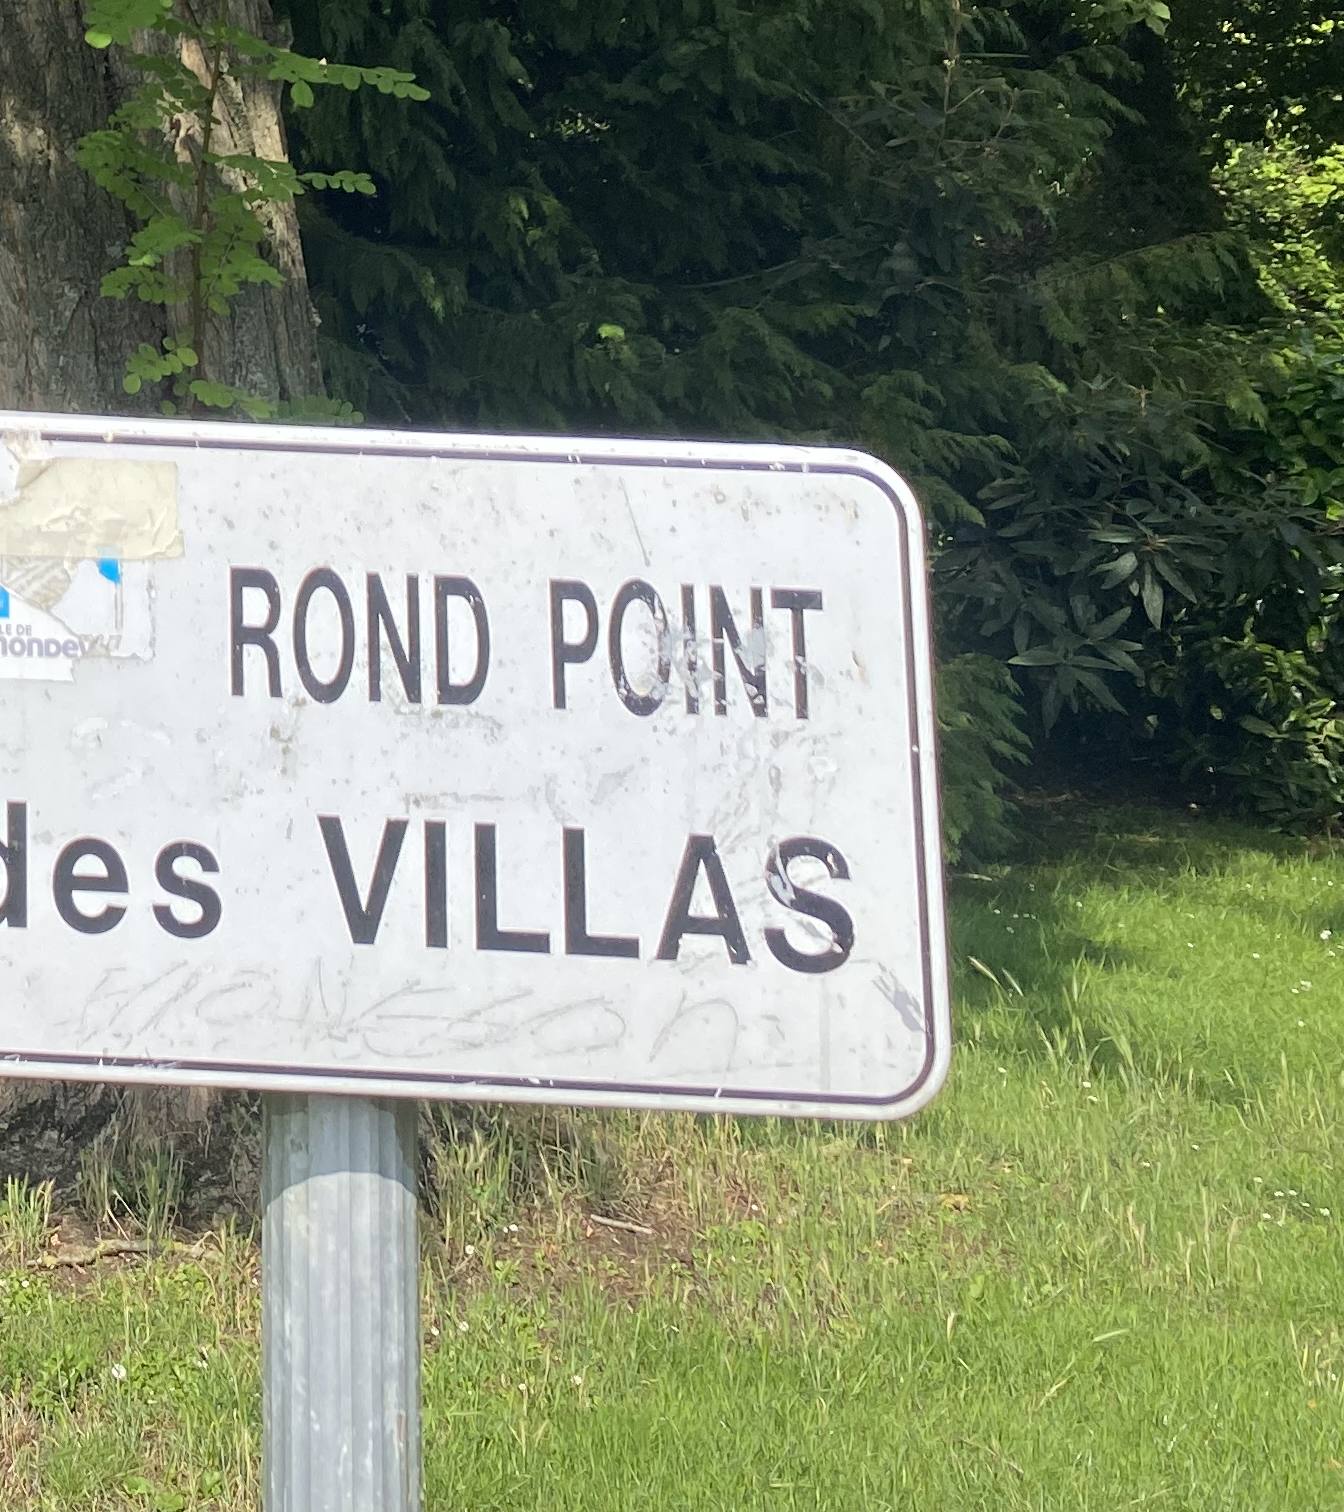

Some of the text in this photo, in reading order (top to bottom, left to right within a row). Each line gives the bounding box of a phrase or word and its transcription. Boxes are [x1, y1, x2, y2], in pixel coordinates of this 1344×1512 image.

[15, 623, 33, 637] DE
[229, 567, 823, 720] ROND POINT
[317, 814, 854, 974] VILLAS
